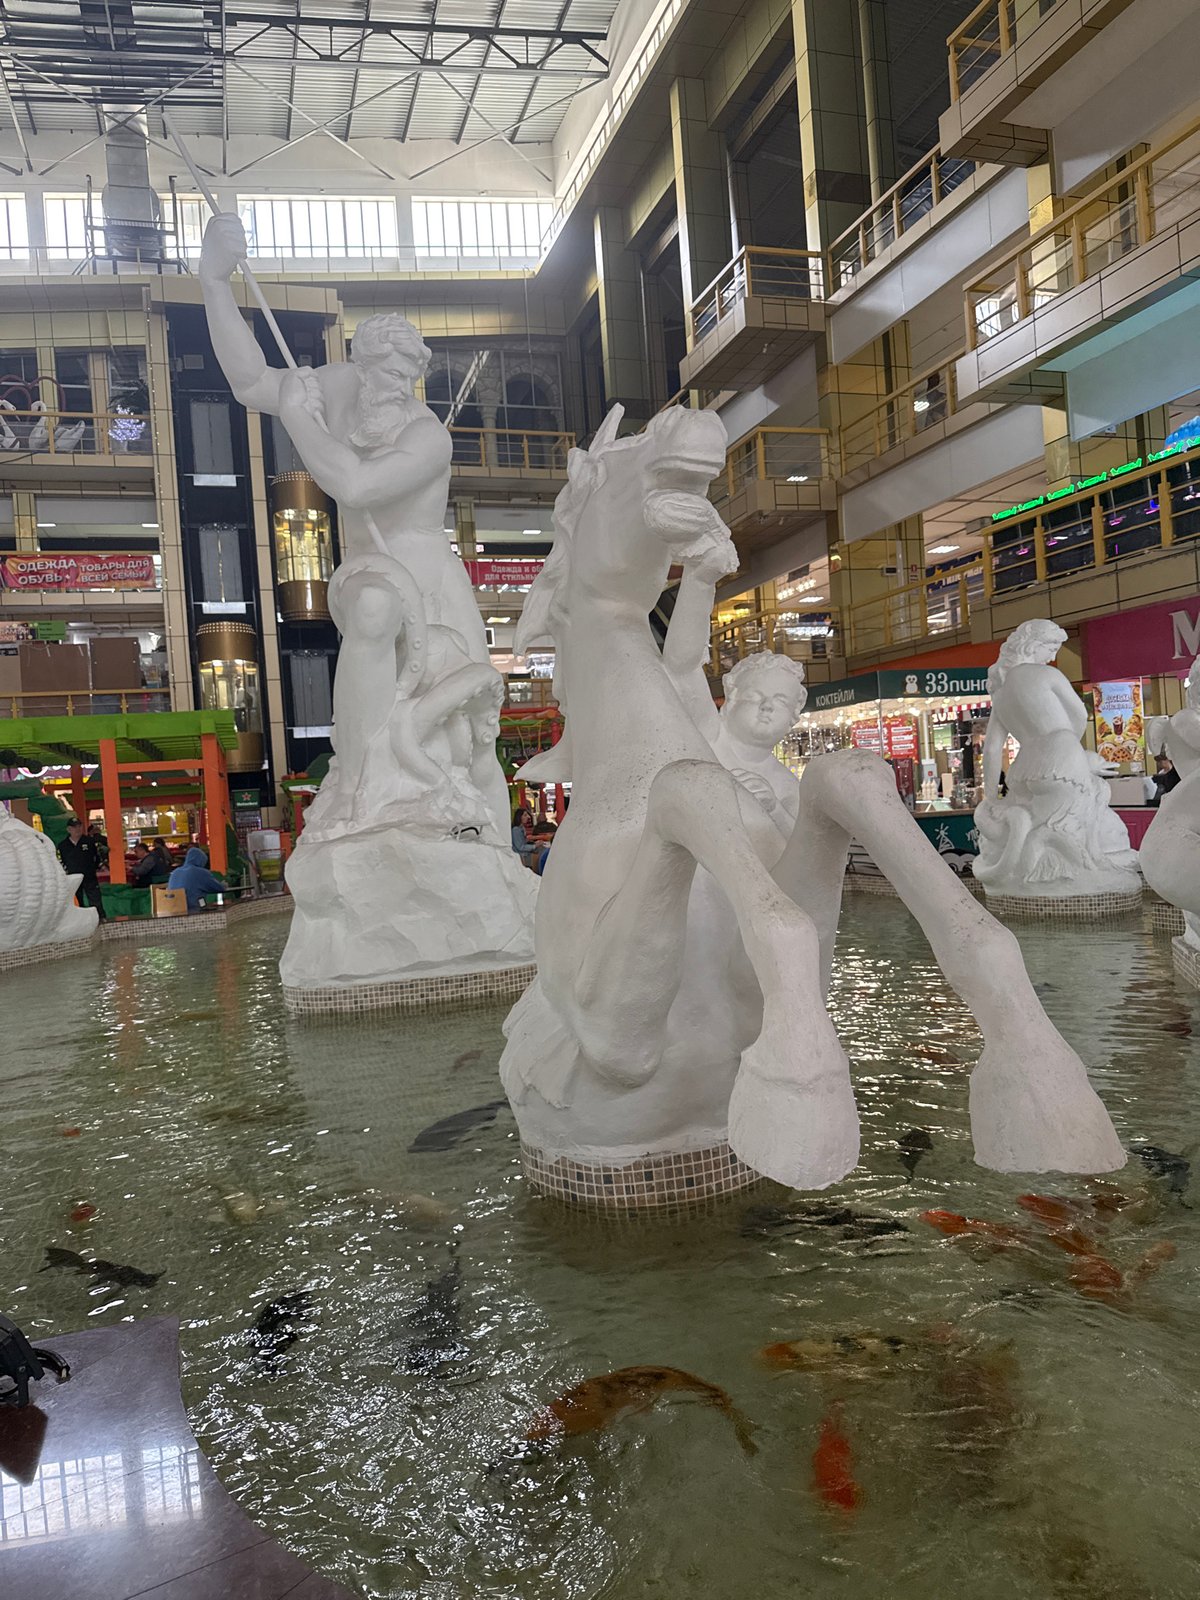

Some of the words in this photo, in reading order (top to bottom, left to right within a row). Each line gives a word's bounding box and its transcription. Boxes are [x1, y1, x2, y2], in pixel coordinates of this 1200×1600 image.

[17, 559, 77, 572] ОДЕЖДА
[80, 562, 125, 572] ТОВАРЫ
[127, 559, 150, 569] ДЛЯ
[491, 564, 522, 573] Одежда
[18, 573, 63, 585] ОБУВЬ
[81, 572, 109, 583] ВСЕЙ
[111, 570, 147, 581] СЕМЬИ
[815, 689, 855, 707] КОКТЕЙЛИ
